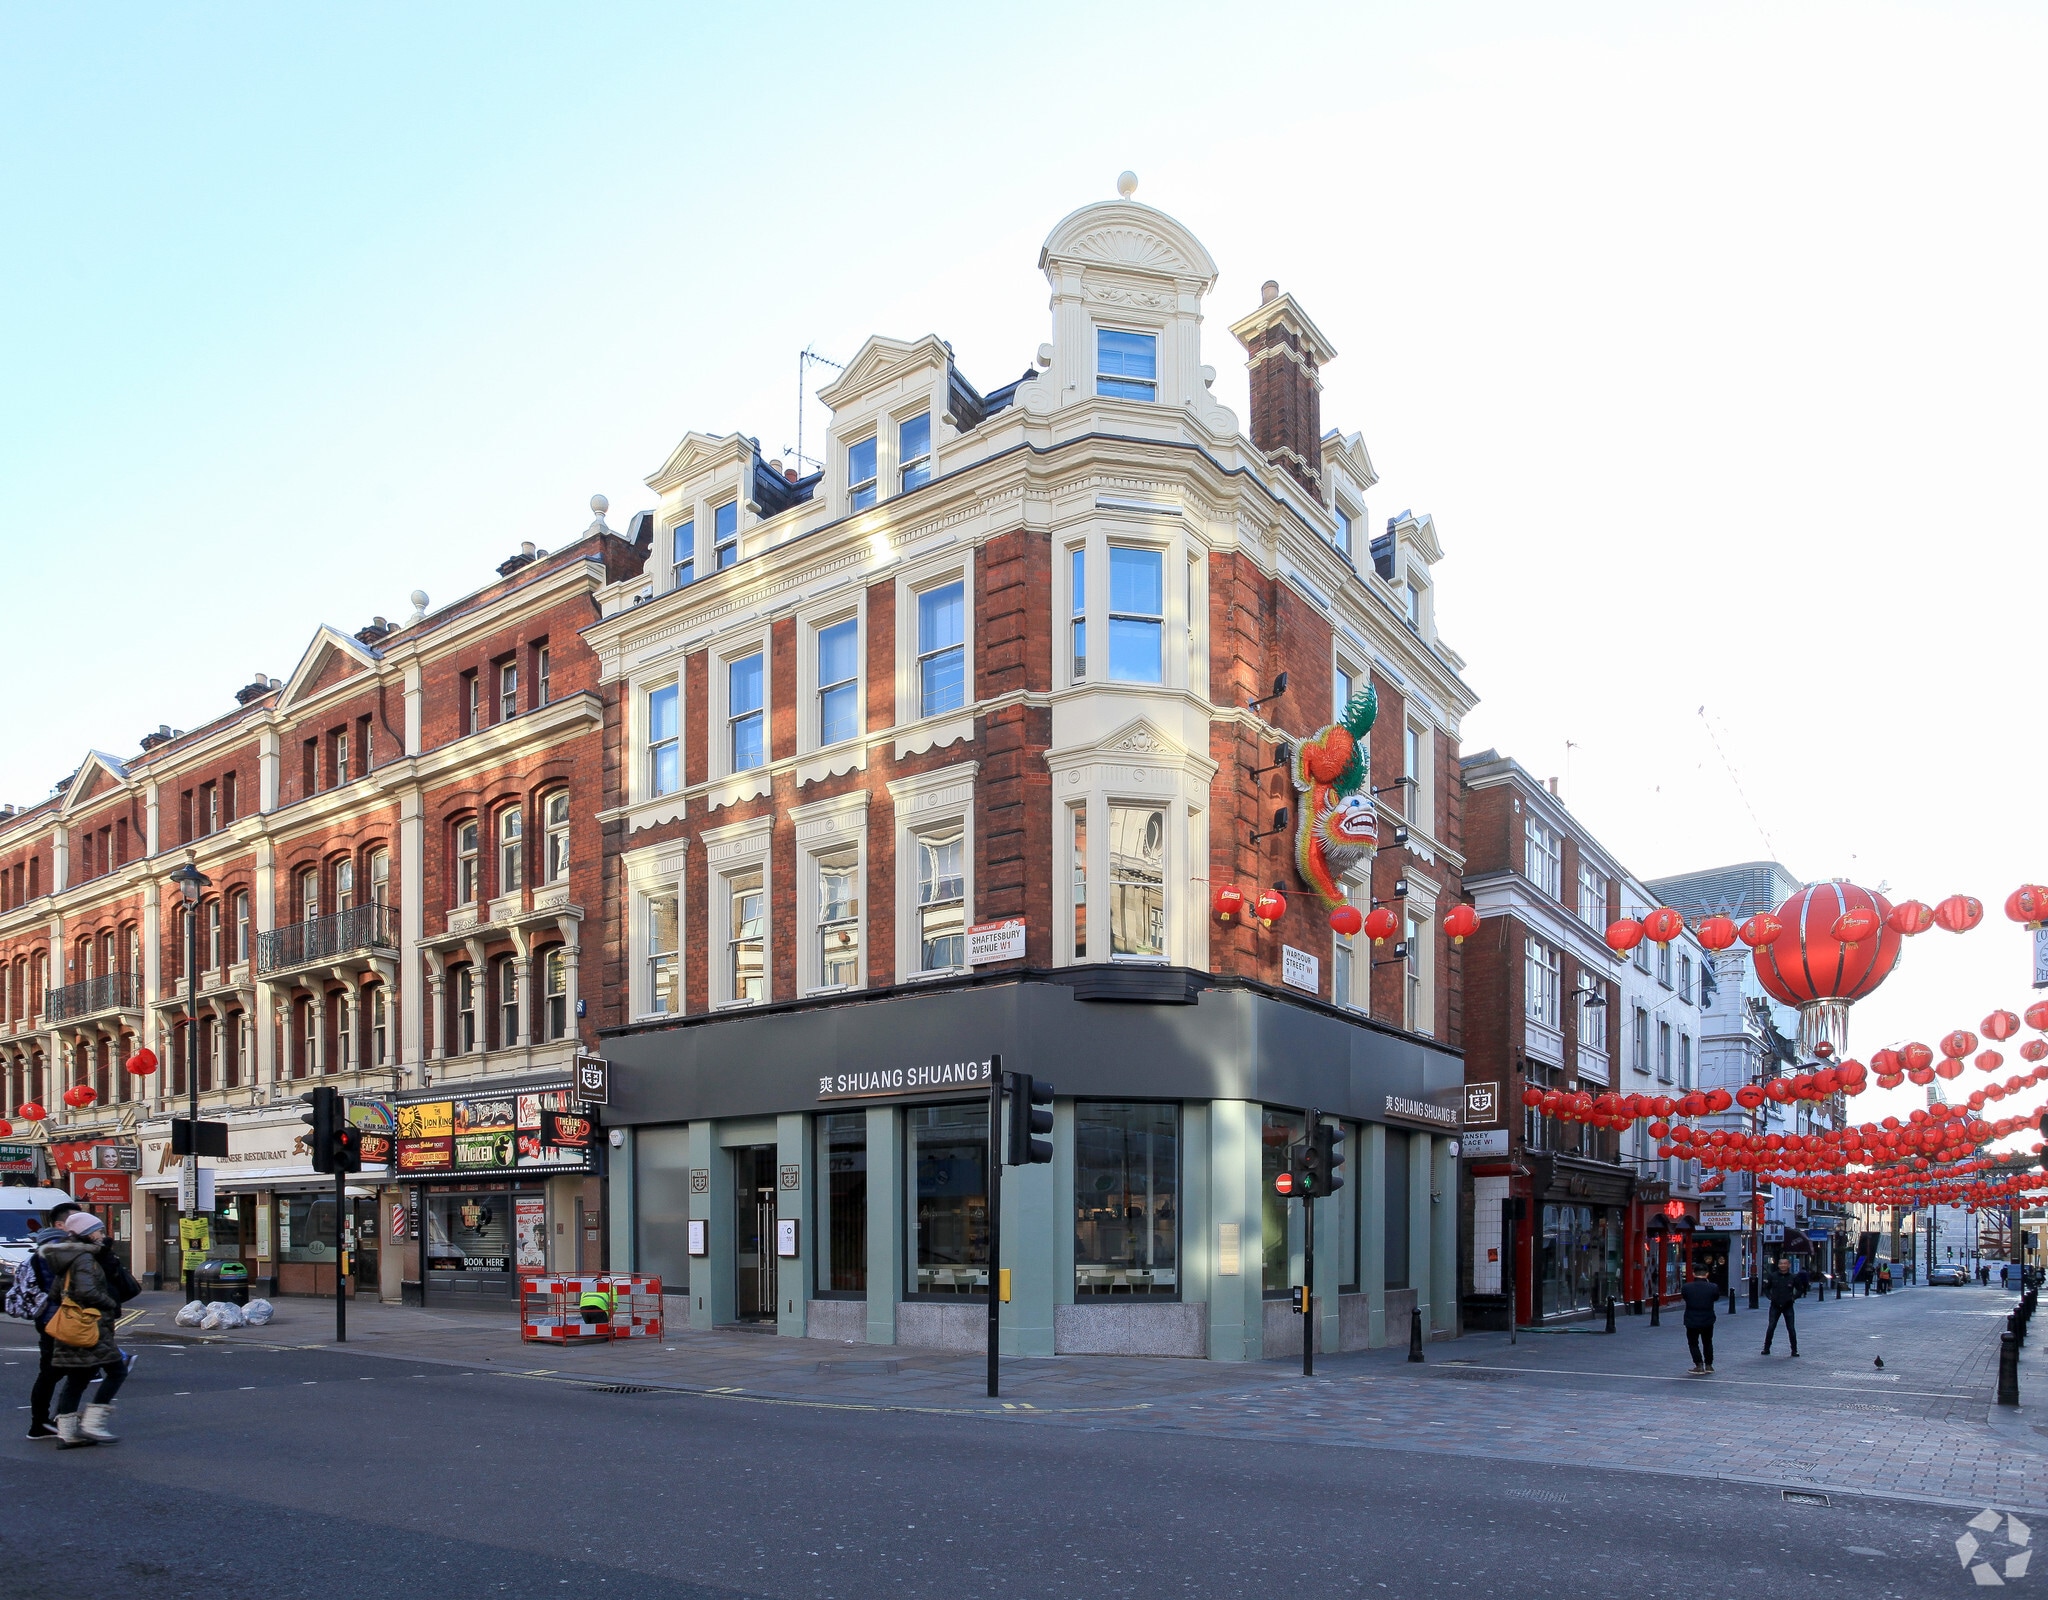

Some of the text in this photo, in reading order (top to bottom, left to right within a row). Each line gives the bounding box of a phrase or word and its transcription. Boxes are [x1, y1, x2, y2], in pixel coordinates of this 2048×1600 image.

[971, 929, 1021, 945] SHAFTESBURY
[2036, 929, 2048, 944] CO
[971, 940, 1011, 954] AVENUE W1
[1286, 948, 1312, 965] WARDOUR
[1286, 958, 1305, 971] STREET
[1305, 965, 1313, 975] W1
[837, 1069, 903, 1092] SHUANG
[906, 1061, 978, 1086] SHUANG
[1394, 1096, 1423, 1117] SHUANG
[1424, 1103, 1450, 1123] SHUANG
[424, 1116, 452, 1129] LION KING
[559, 1117, 581, 1127] THEATRE
[563, 1125, 577, 1135] CAFE
[148, 1142, 162, 1151] NEW
[361, 1143, 376, 1151] CAFE
[216, 1150, 287, 1164] CHINESE RESTAURANT
[1640, 1189, 1665, 1200] Viet
[461, 1205, 481, 1216] THEATRE
[464, 1215, 478, 1227] CAFE
[463, 1257, 484, 1266] BOOK
[486, 1257, 505, 1267] HERE
